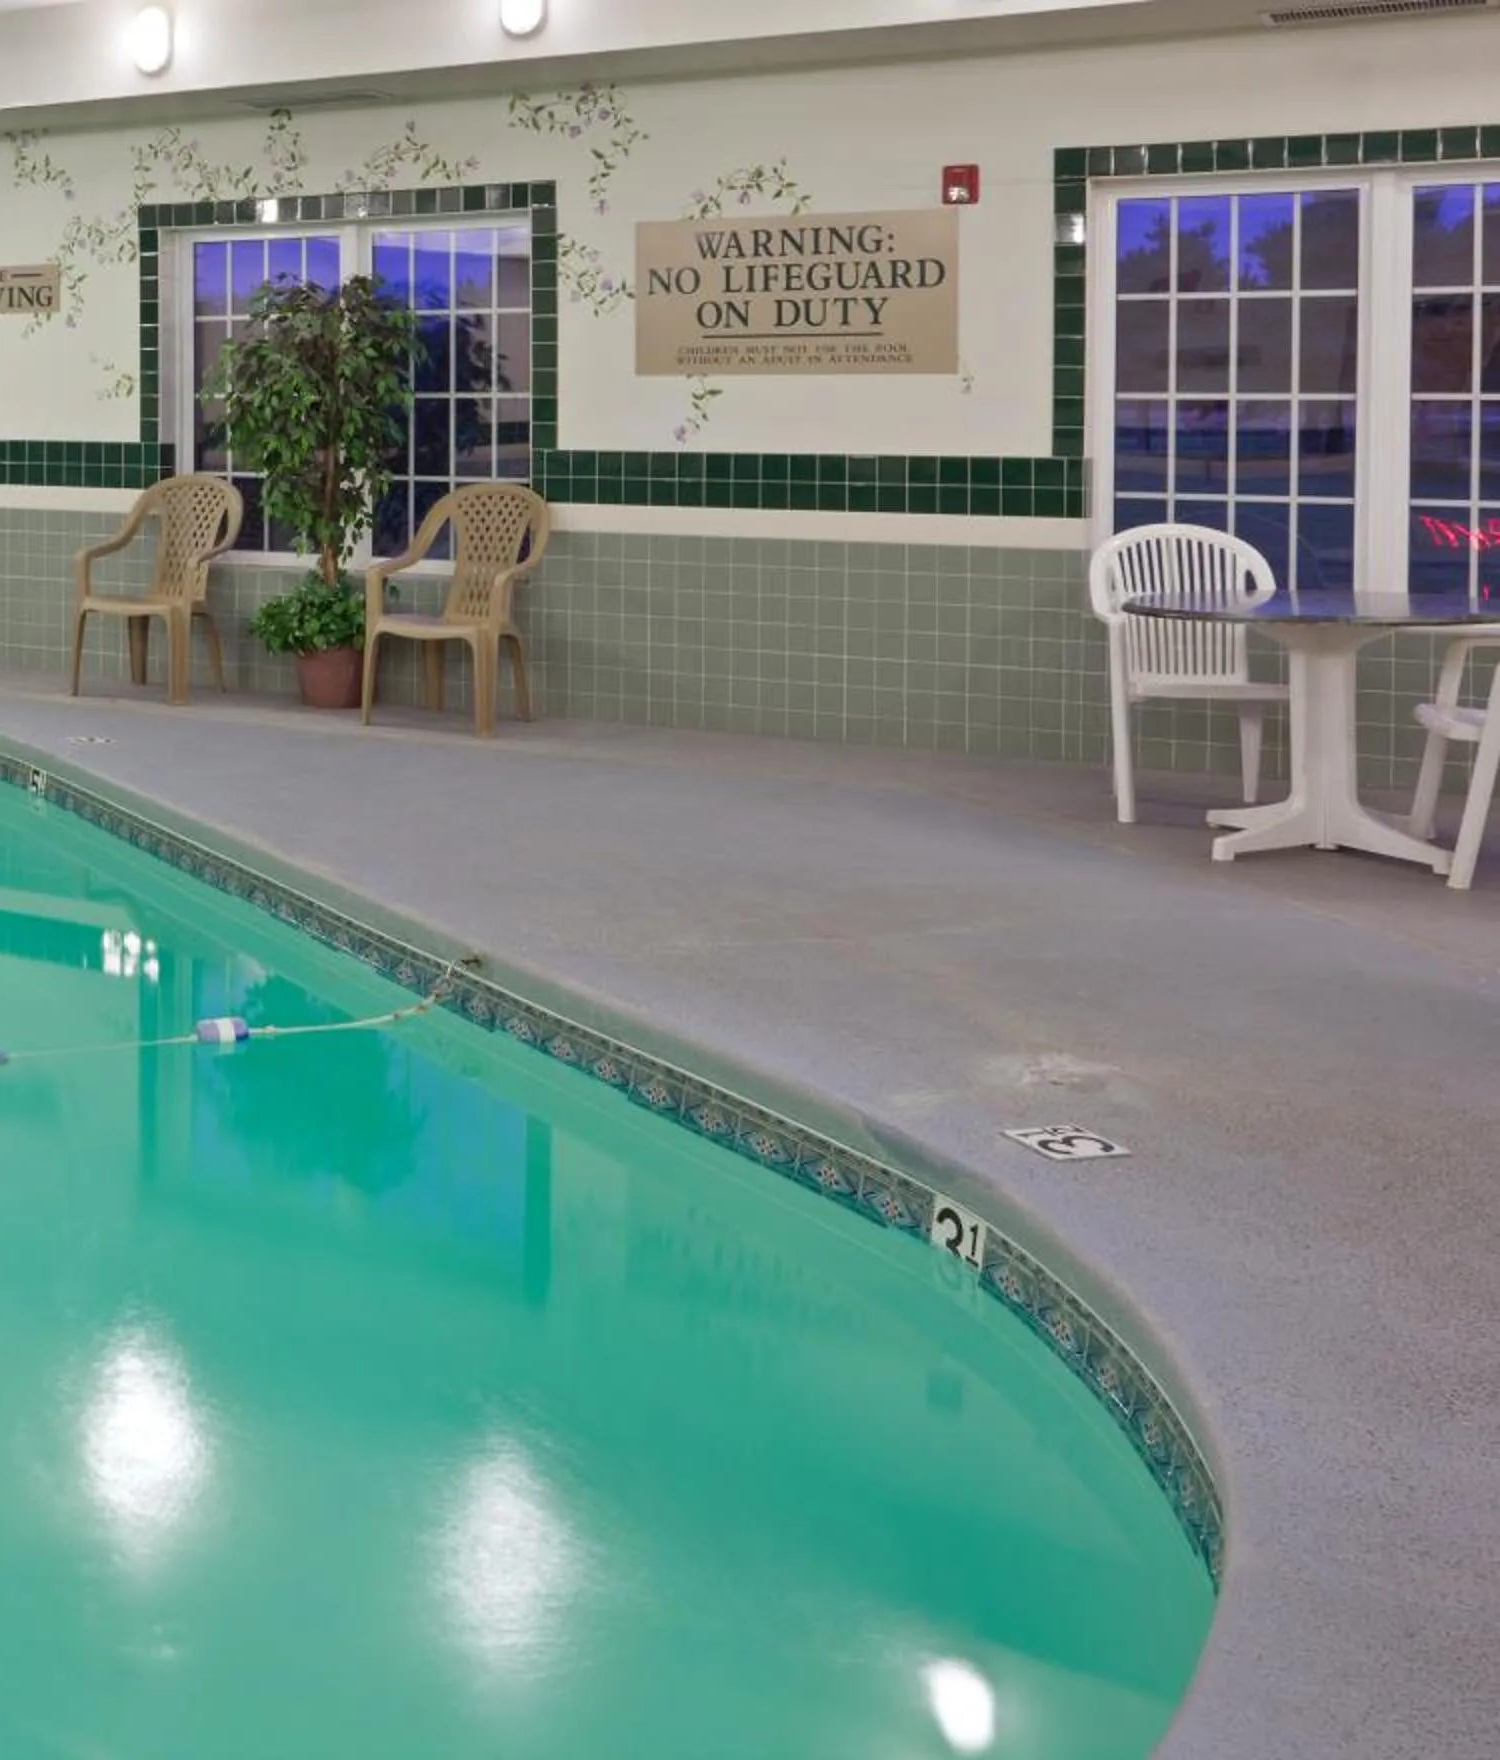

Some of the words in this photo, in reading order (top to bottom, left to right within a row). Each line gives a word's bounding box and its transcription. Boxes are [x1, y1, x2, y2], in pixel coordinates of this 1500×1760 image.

[696, 225, 895, 259] WARNING:
[648, 266, 700, 295] NO
[723, 258, 946, 293] LIFEGUARD
[696, 300, 750, 329] ON
[773, 296, 889, 327] DUTY
